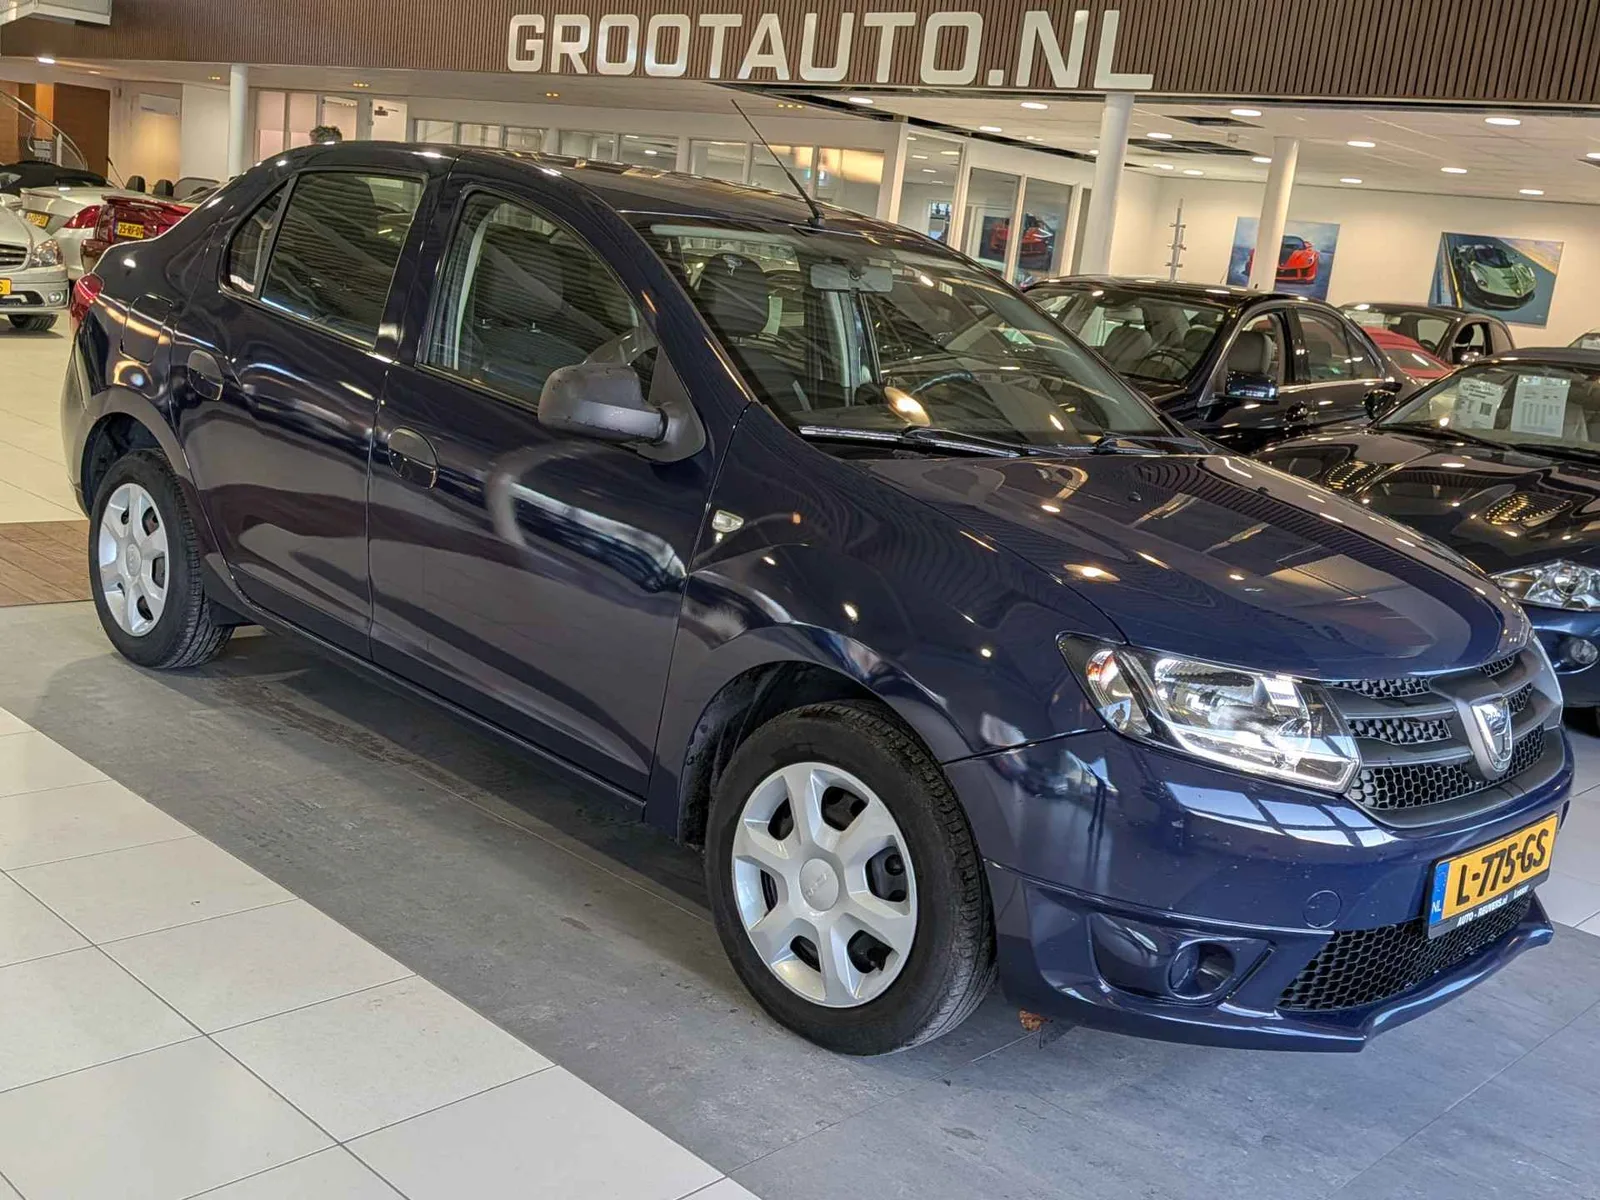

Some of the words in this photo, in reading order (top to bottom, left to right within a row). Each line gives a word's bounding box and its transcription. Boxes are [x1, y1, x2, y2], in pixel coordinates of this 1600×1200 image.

[507, 10, 1153, 89] GROOTAUTO.NL
[1456, 829, 1548, 906] L-775-GS
[1431, 900, 1442, 913] NL
[1457, 913, 1474, 927] AUTO
